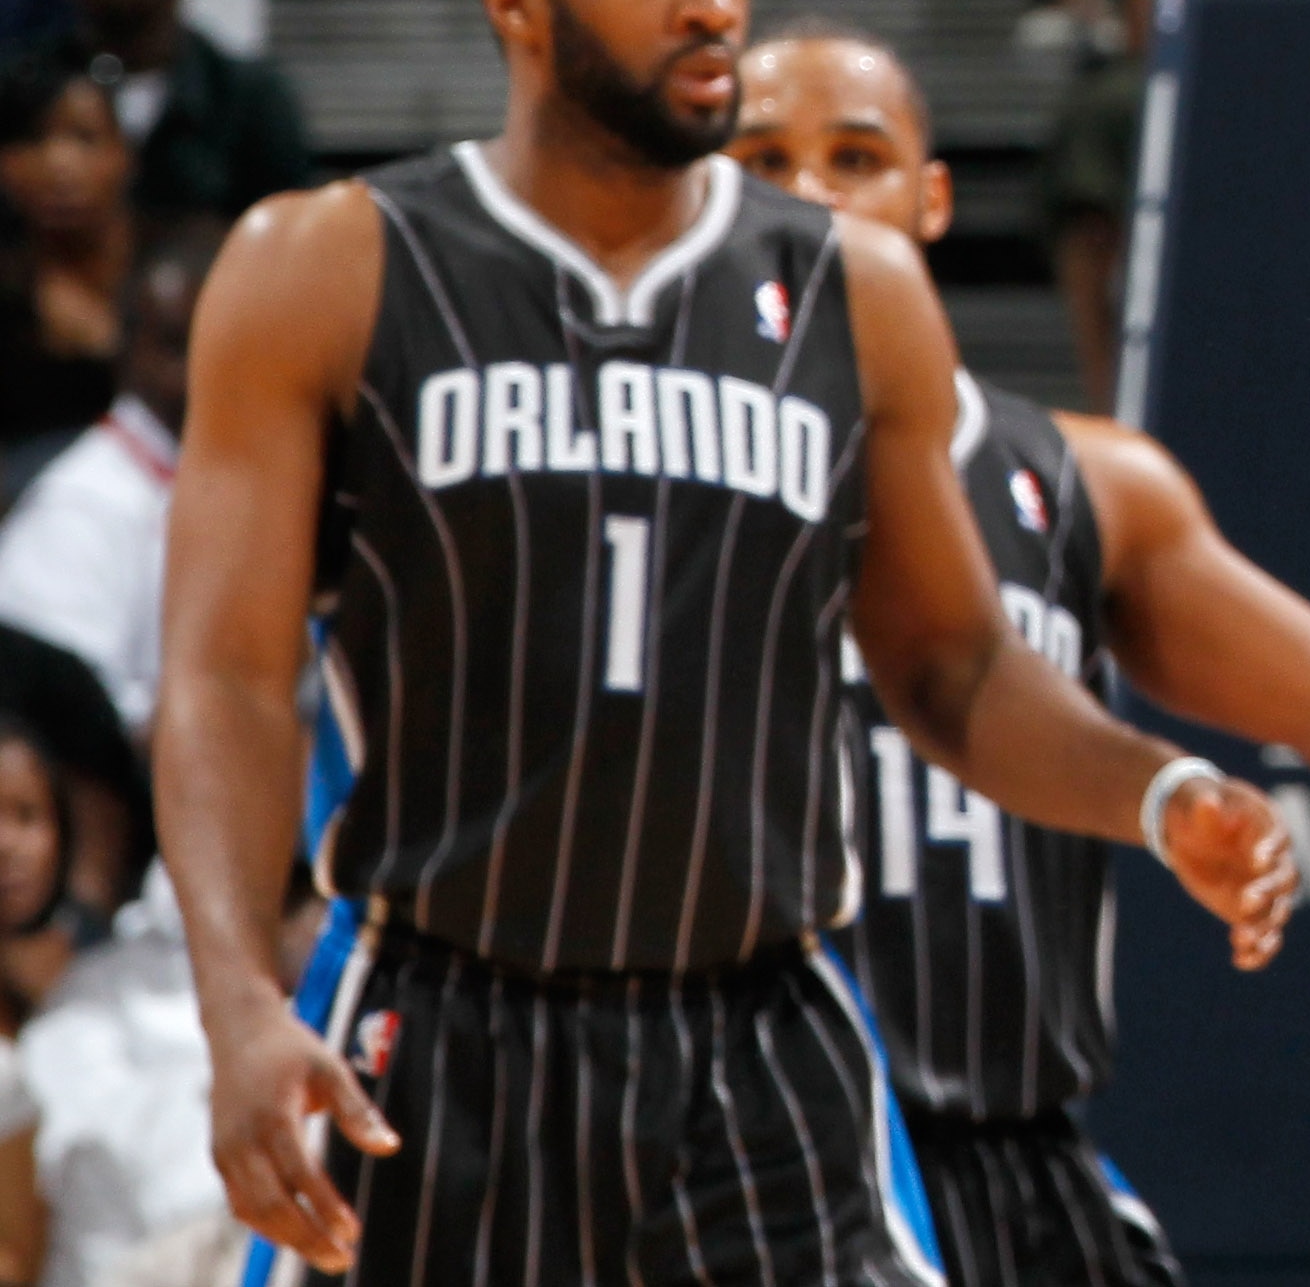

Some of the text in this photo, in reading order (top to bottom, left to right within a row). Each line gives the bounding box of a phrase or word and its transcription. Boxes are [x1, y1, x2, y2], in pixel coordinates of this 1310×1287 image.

[416, 360, 833, 524] ORLANDO
[603, 513, 652, 694] 1
[868, 724, 1009, 903] 14
